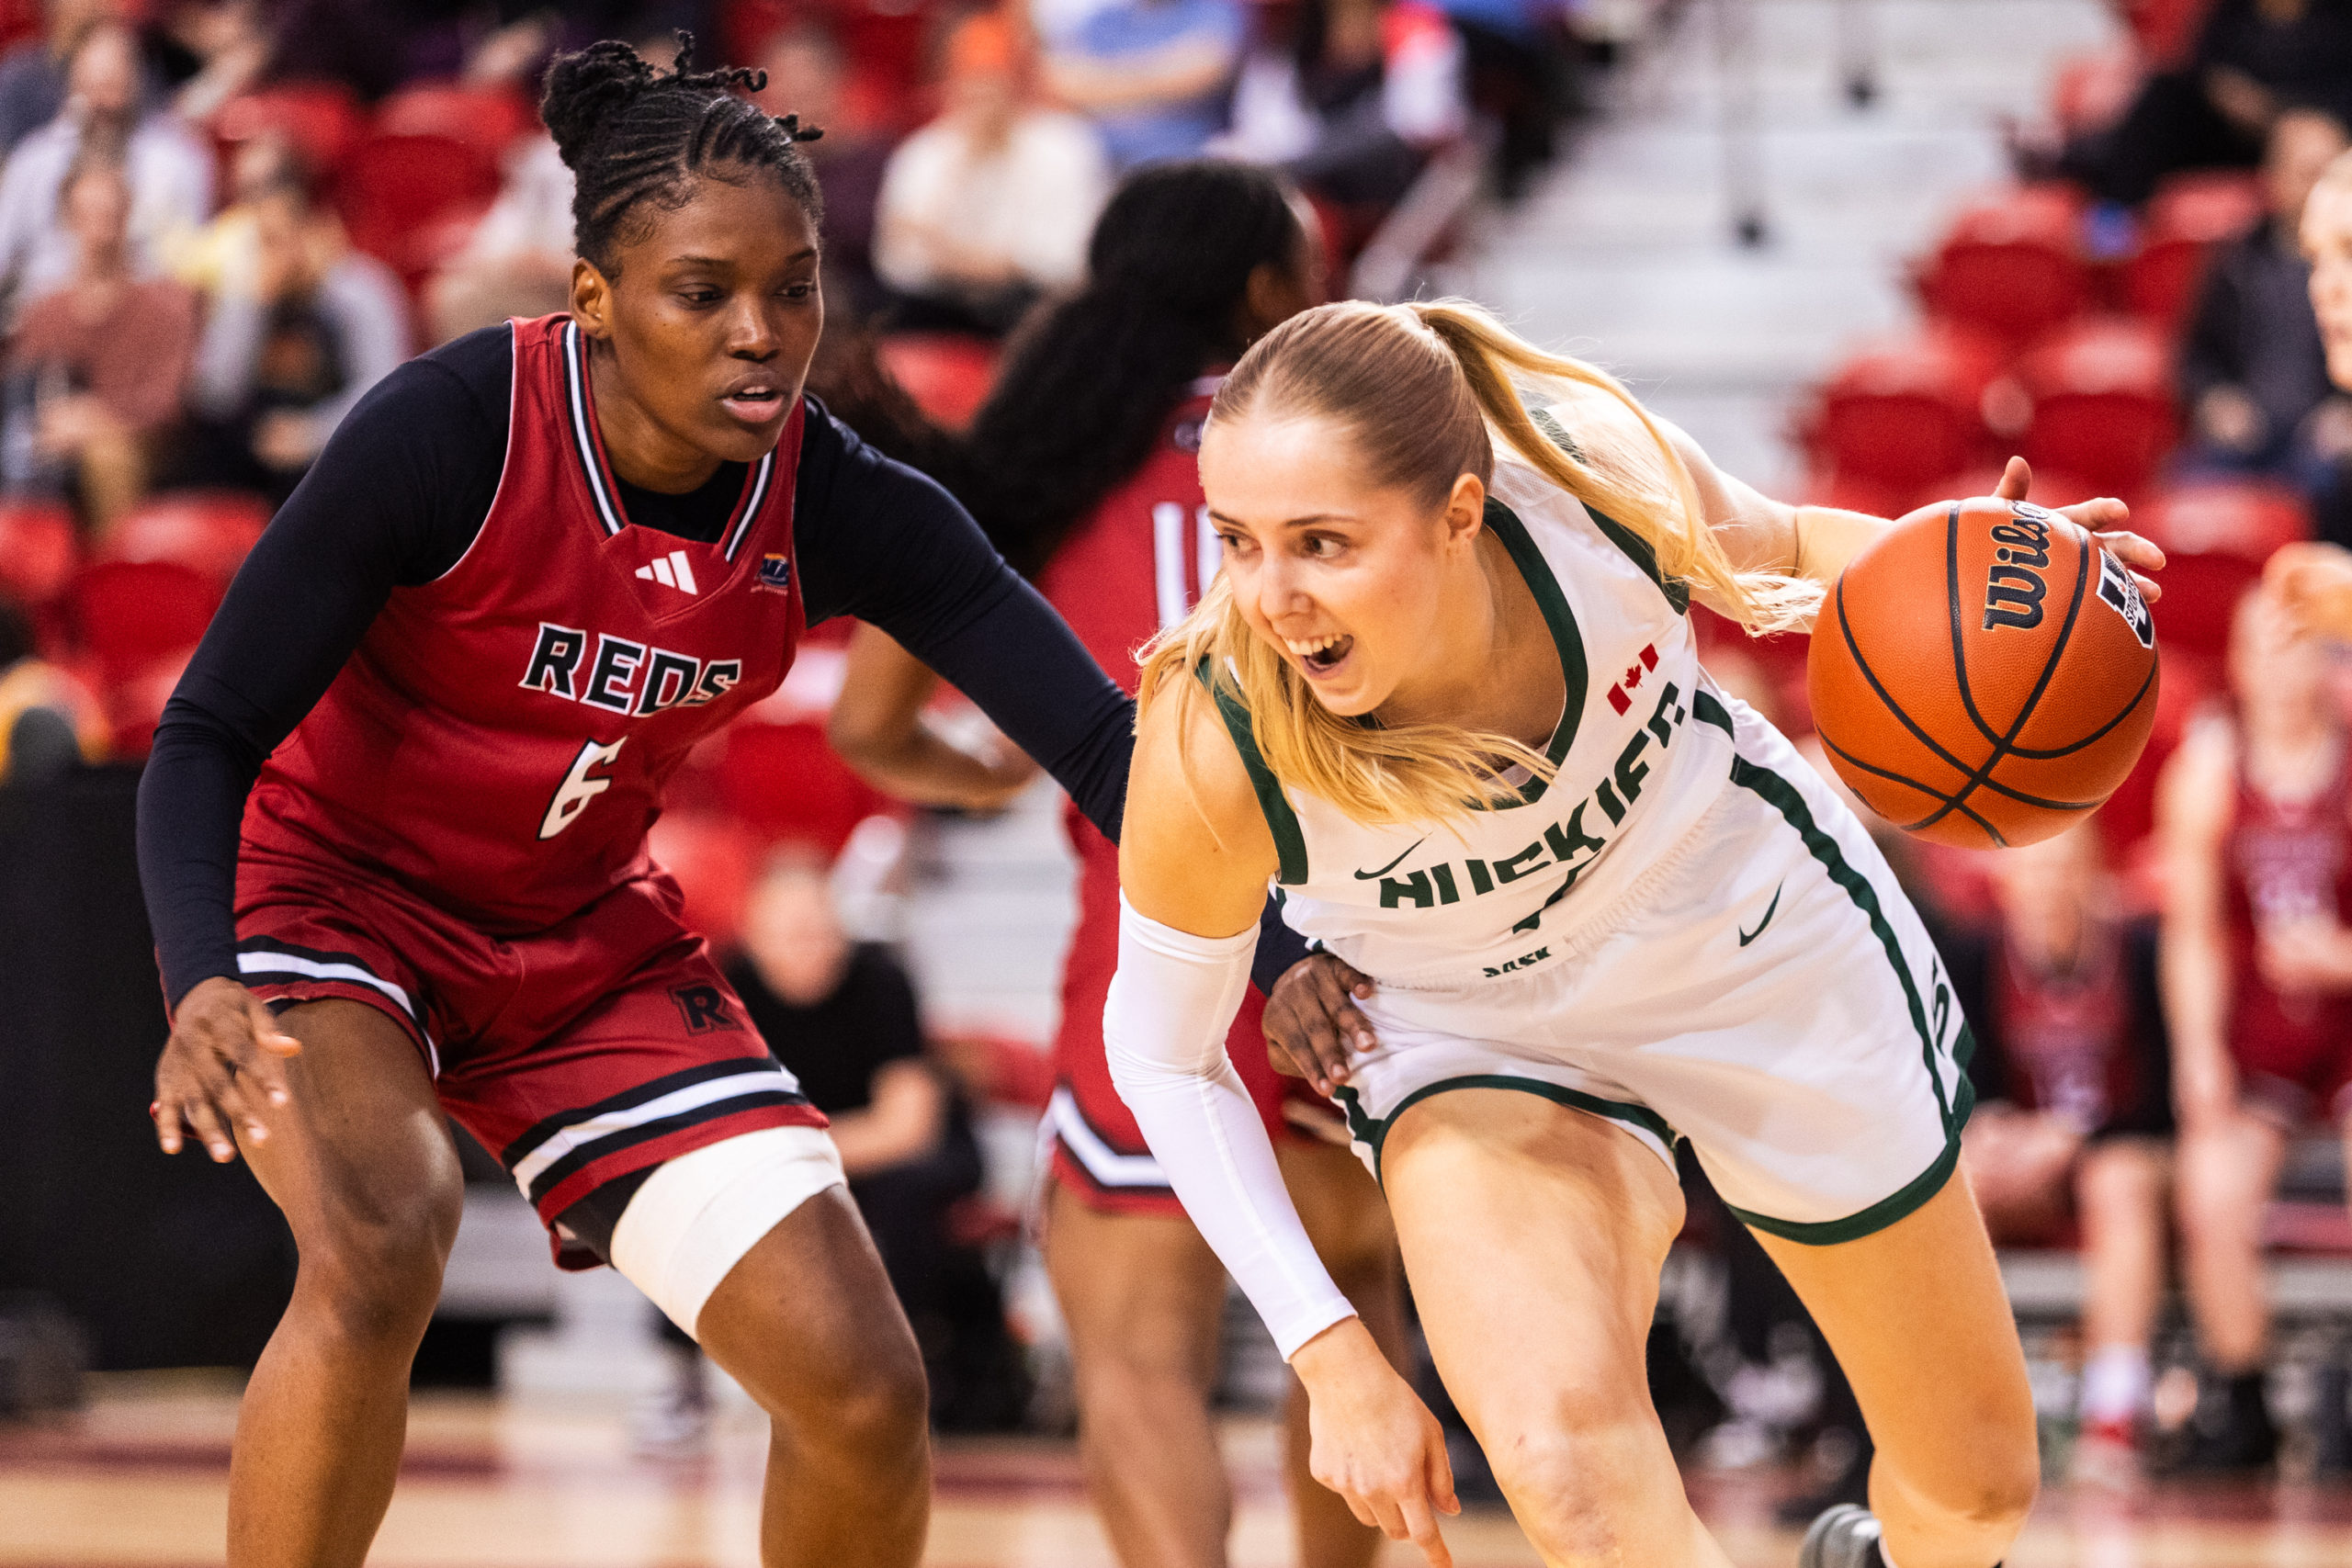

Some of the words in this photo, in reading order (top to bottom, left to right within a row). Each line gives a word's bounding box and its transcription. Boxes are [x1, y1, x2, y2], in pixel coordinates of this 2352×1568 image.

[1982, 500, 2051, 632] Wilso
[518, 622, 741, 717] REDS
[536, 734, 628, 841] 6
[668, 979, 744, 1036] R
